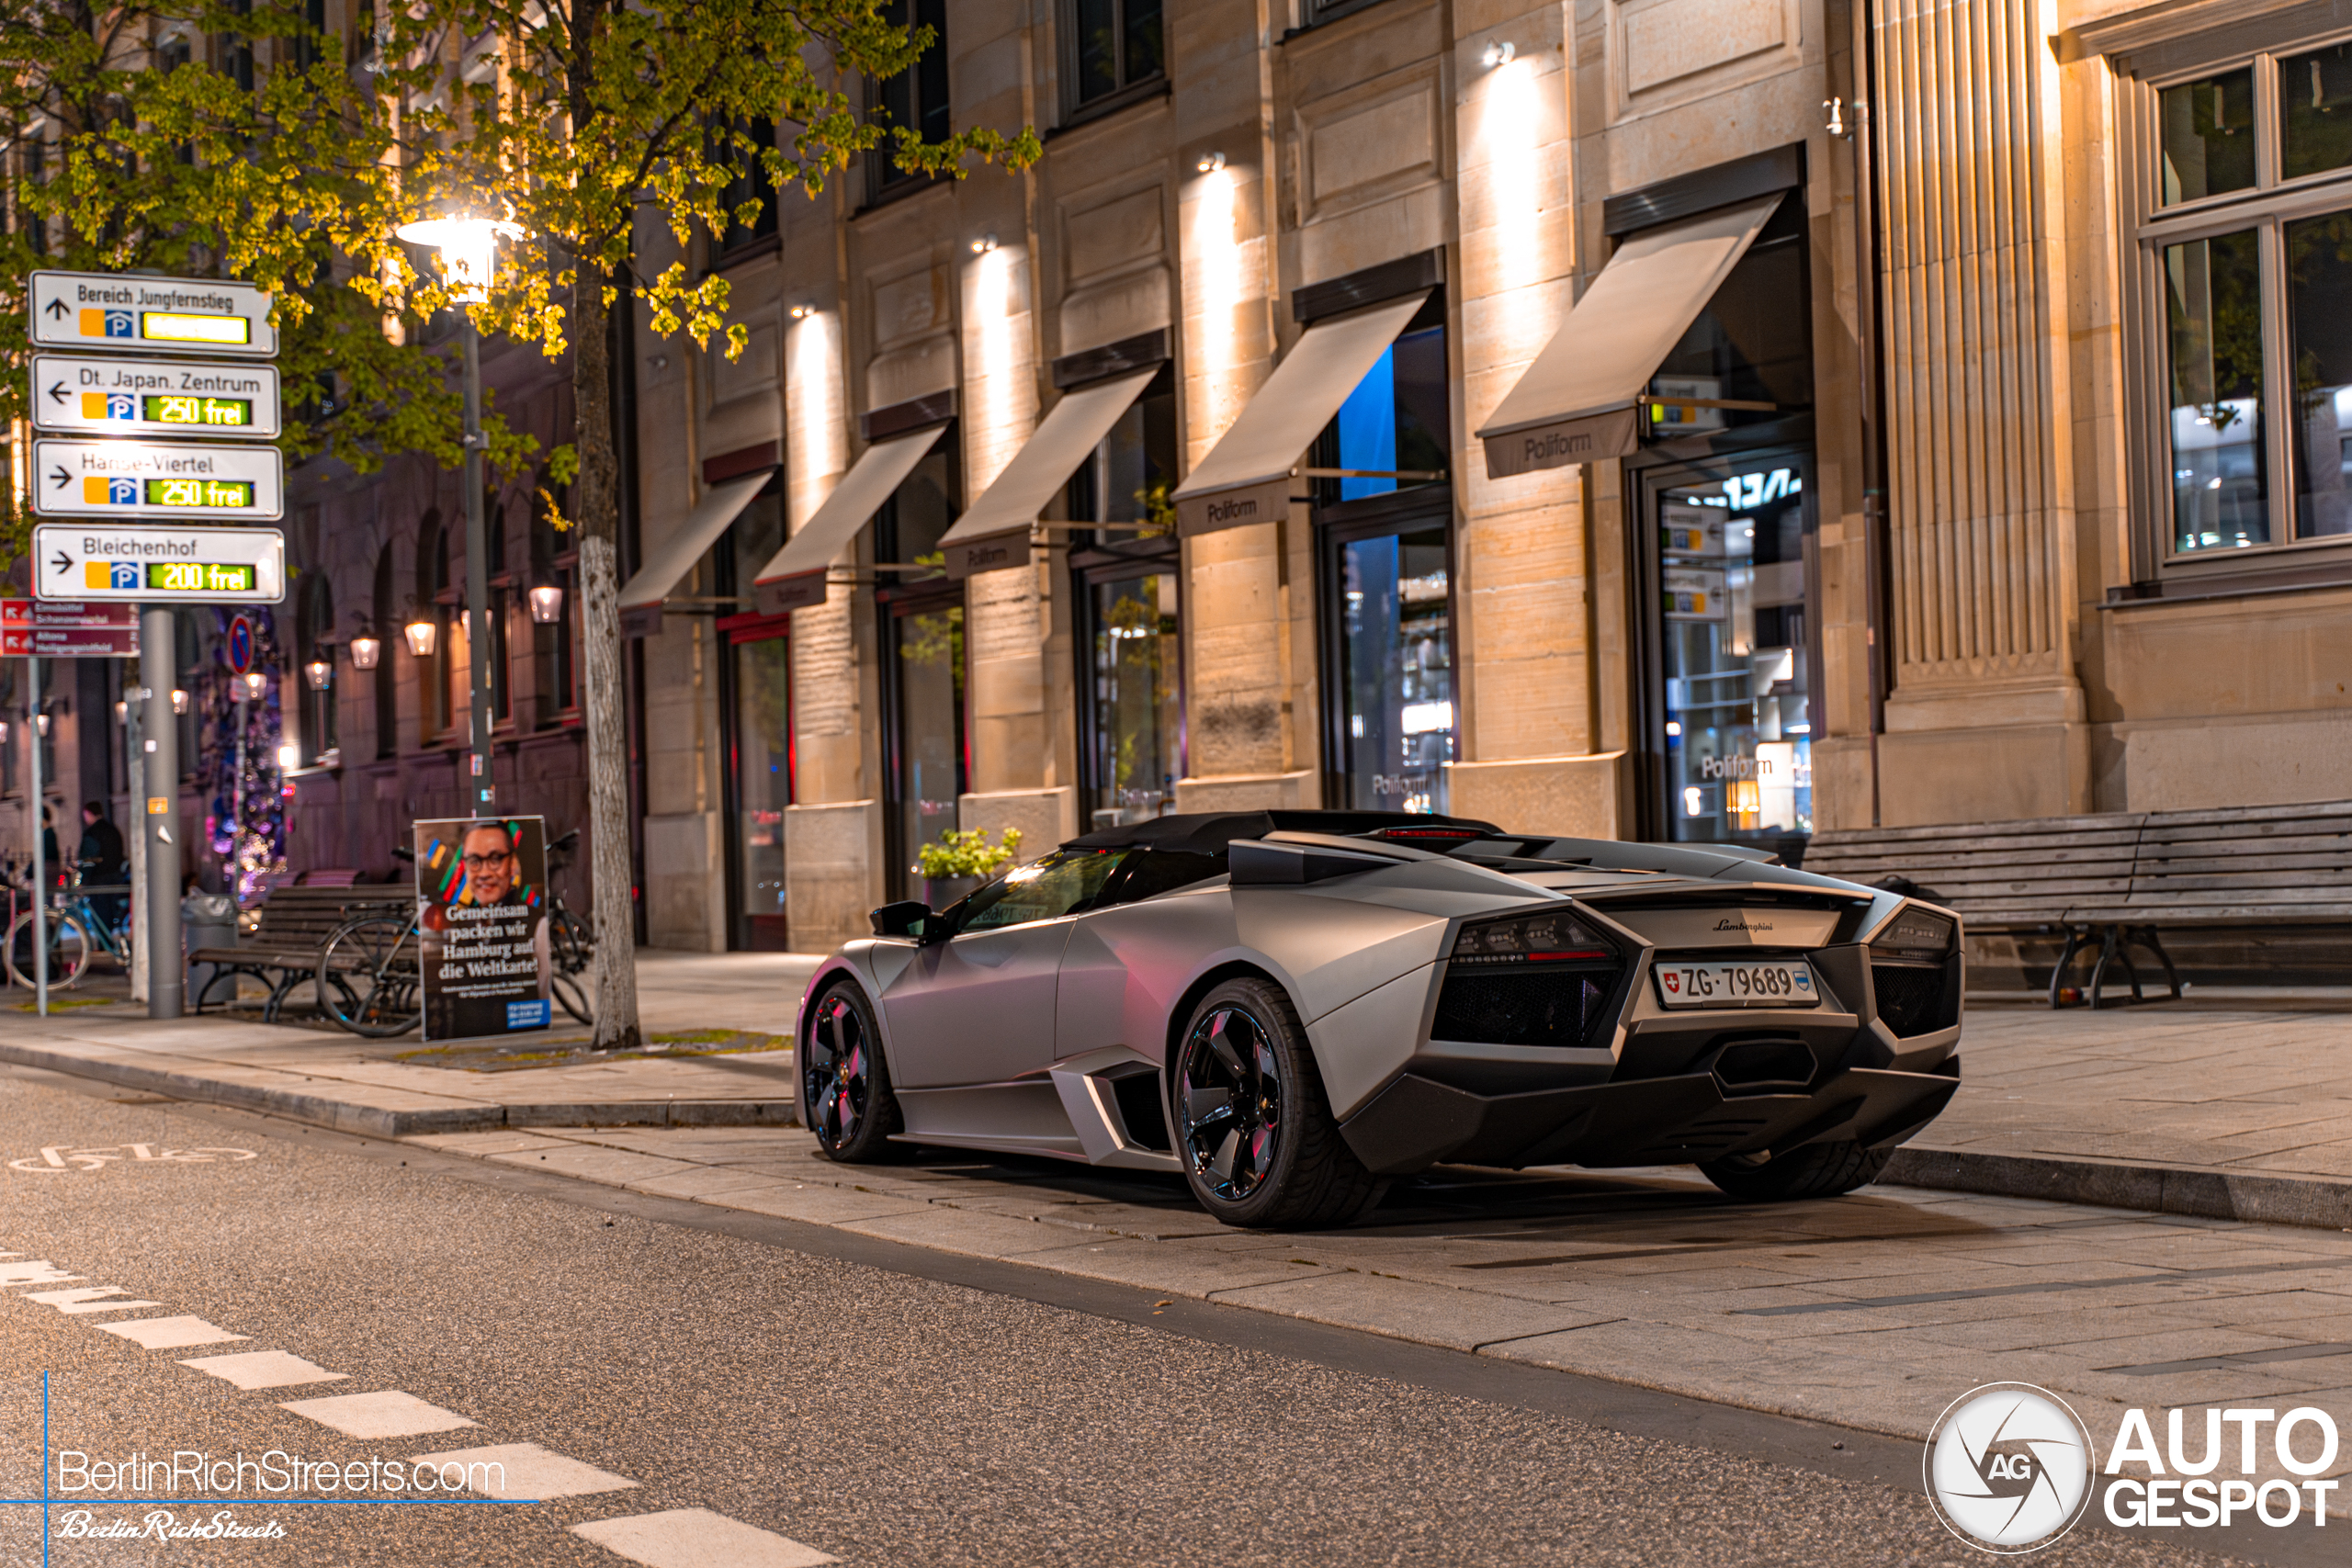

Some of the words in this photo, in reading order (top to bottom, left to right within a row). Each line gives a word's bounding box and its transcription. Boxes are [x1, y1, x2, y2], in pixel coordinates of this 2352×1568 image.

[78, 285, 132, 304] Bereich
[137, 288, 233, 312] Jungfernstieg
[80, 368, 106, 386] Dt.
[111, 370, 175, 391] Japan.
[180, 372, 261, 393] Zentrum
[159, 396, 199, 423] 250
[203, 398, 242, 425] frei
[1525, 433, 1591, 461] Poliform
[82, 453, 214, 474] Hanse-Viertel
[161, 479, 202, 506] 250
[206, 479, 244, 507] frei
[1207, 499, 1257, 524] Poliform
[84, 537, 198, 557] Bleichenhof
[162, 563, 203, 591] 200
[208, 564, 246, 592] frei
[1702, 754, 1772, 779] Poliform
[1372, 773, 1427, 795] Poliform
[446, 903, 529, 921] Gemeinsam
[450, 921, 503, 943] packen
[504, 920, 527, 937] wir
[1713, 919, 1773, 933] Lamborghini
[442, 942, 512, 960] Hamburg
[513, 937, 535, 955] auf
[438, 963, 465, 980] die
[466, 957, 538, 977] Weltkarte!
